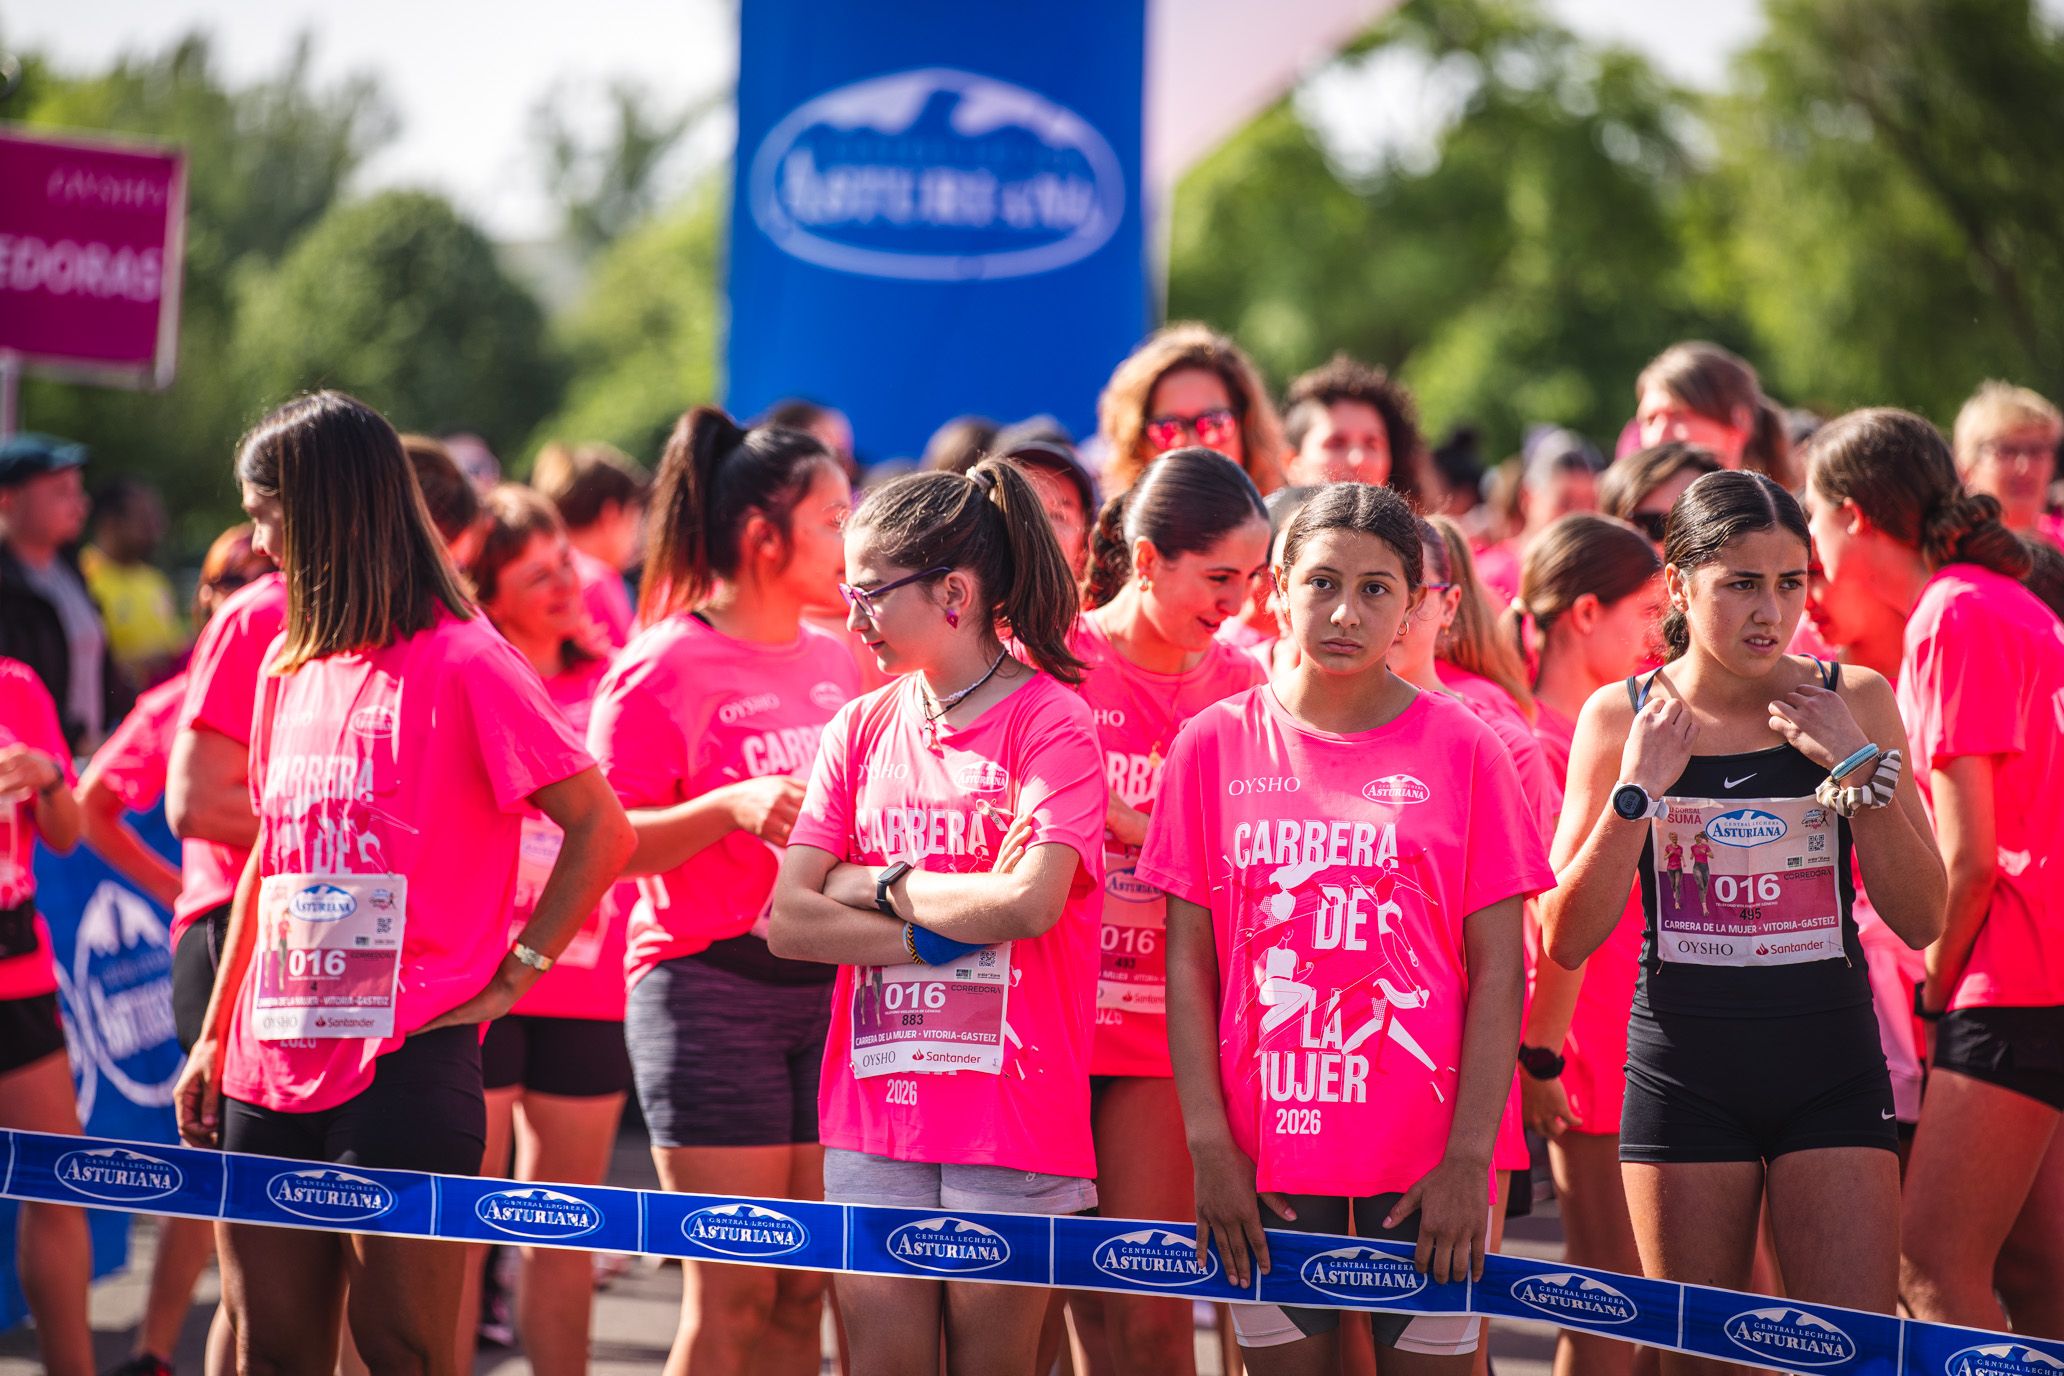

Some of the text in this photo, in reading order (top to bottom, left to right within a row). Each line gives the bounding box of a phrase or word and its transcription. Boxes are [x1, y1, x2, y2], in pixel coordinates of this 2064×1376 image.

[1228, 776, 1301, 796] OYSHO
[1367, 785, 1424, 799] ASTURIANA
[1667, 813, 1702, 825] SUMA
[1713, 823, 1781, 838] ASTURIANA
[855, 807, 990, 857] CARRERA
[1234, 819, 1399, 869] CARRERA
[1784, 869, 1831, 880] CORREDORA
[1715, 874, 1781, 903] 016
[1312, 884, 1375, 950] DE
[1664, 915, 1836, 934] CARRERA DE LA MUJER VITORIA-GASTEIZ
[1740, 908, 1762, 920] 495
[1100, 925, 1155, 955] 016
[1678, 940, 1825, 957] OYSHO Santander
[288, 949, 347, 977] 016
[885, 983, 947, 1010] 016
[951, 985, 1002, 994] CORREDORA
[327, 1016, 375, 1028] Santander
[902, 1014, 924, 1026] 883
[1300, 987, 1343, 1049] LA
[855, 1029, 997, 1046] CARRERA DE LA MUJER VITORIA-GASTEIZ
[862, 1050, 982, 1068] OYSHO Santander
[885, 1078, 918, 1106] 2026
[1275, 1108, 1322, 1135] 2026
[63, 1157, 172, 1189] ASTURIANA
[275, 1179, 382, 1209] ASTURIANA
[484, 1199, 590, 1227] ASTURIANA
[690, 1217, 796, 1246] ASTURIANA
[915, 1232, 998, 1245] CENTRAL LECHERA
[896, 1233, 1001, 1261] ASTURIANA
[1121, 1246, 1197, 1258] CENTRAL LECHE
[1310, 1262, 1418, 1289] ASTURIANA
[1330, 1261, 1414, 1271] CENTRAL LECHERA
[1520, 1284, 1629, 1318] ASTURIANA
[1539, 1285, 1624, 1305] CENTRAL LECHERA
[1733, 1321, 1846, 1358] ASTURIANA
[1754, 1322, 1842, 1342] CENTRAL LECHERA
